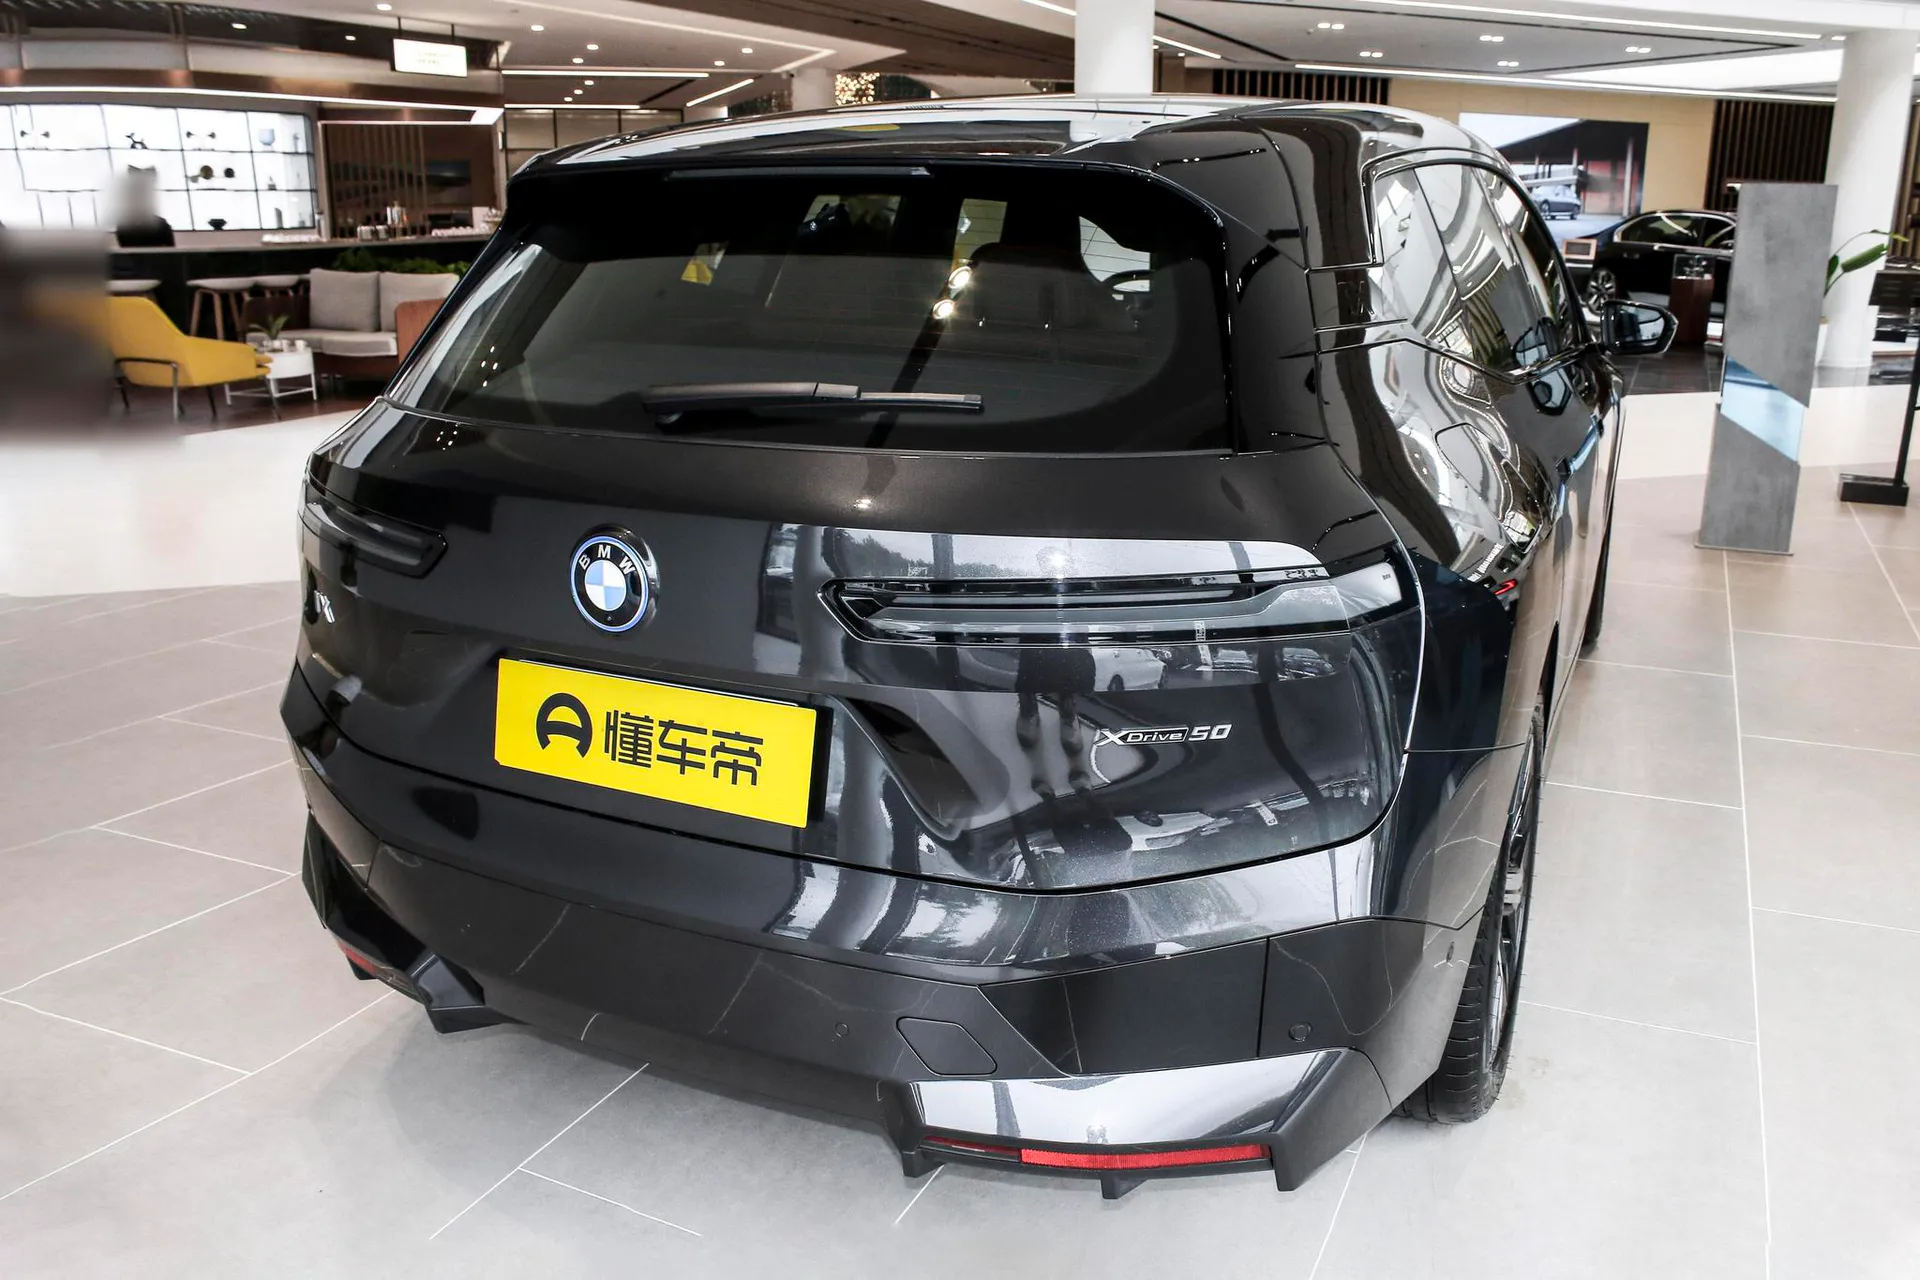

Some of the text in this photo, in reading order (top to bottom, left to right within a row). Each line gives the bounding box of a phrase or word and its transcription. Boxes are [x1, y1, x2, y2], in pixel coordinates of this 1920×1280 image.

[578, 544, 636, 575] BMW
[604, 709, 764, 786] 懂车帝
[1189, 724, 1232, 741] 50
